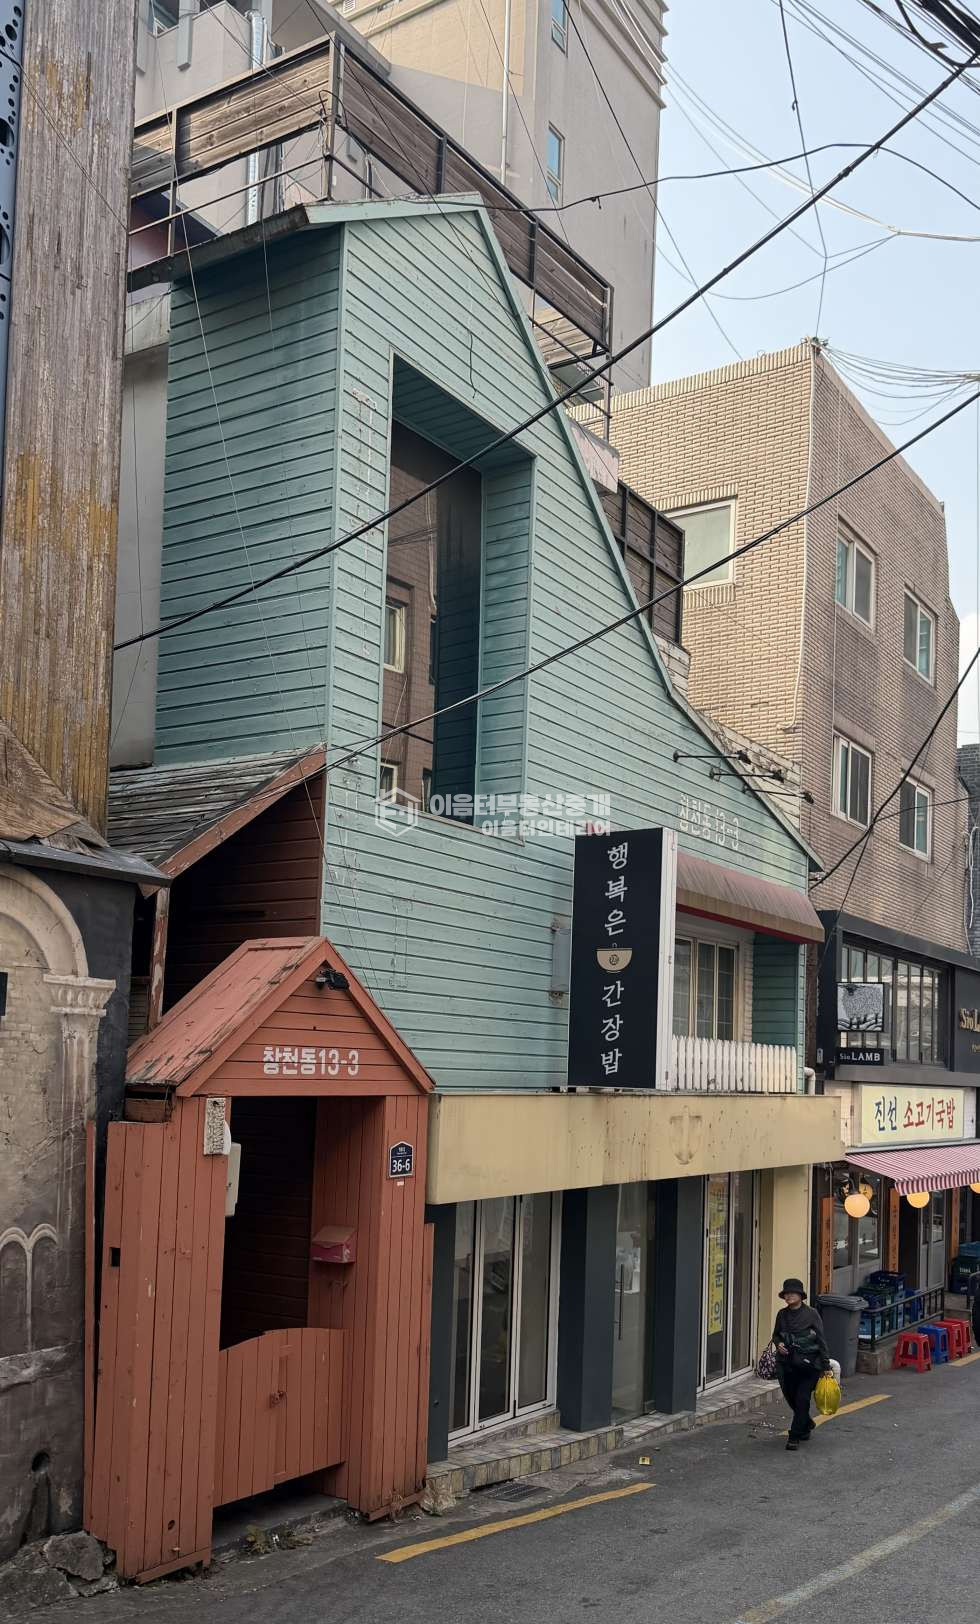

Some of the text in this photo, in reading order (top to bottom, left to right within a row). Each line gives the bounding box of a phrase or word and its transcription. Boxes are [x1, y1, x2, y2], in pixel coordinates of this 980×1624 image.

[600, 842, 629, 1076] 행복은 간장밥
[874, 1095, 956, 1133] 진선 소고기국밥
[392, 1158, 411, 1173] 36-6
